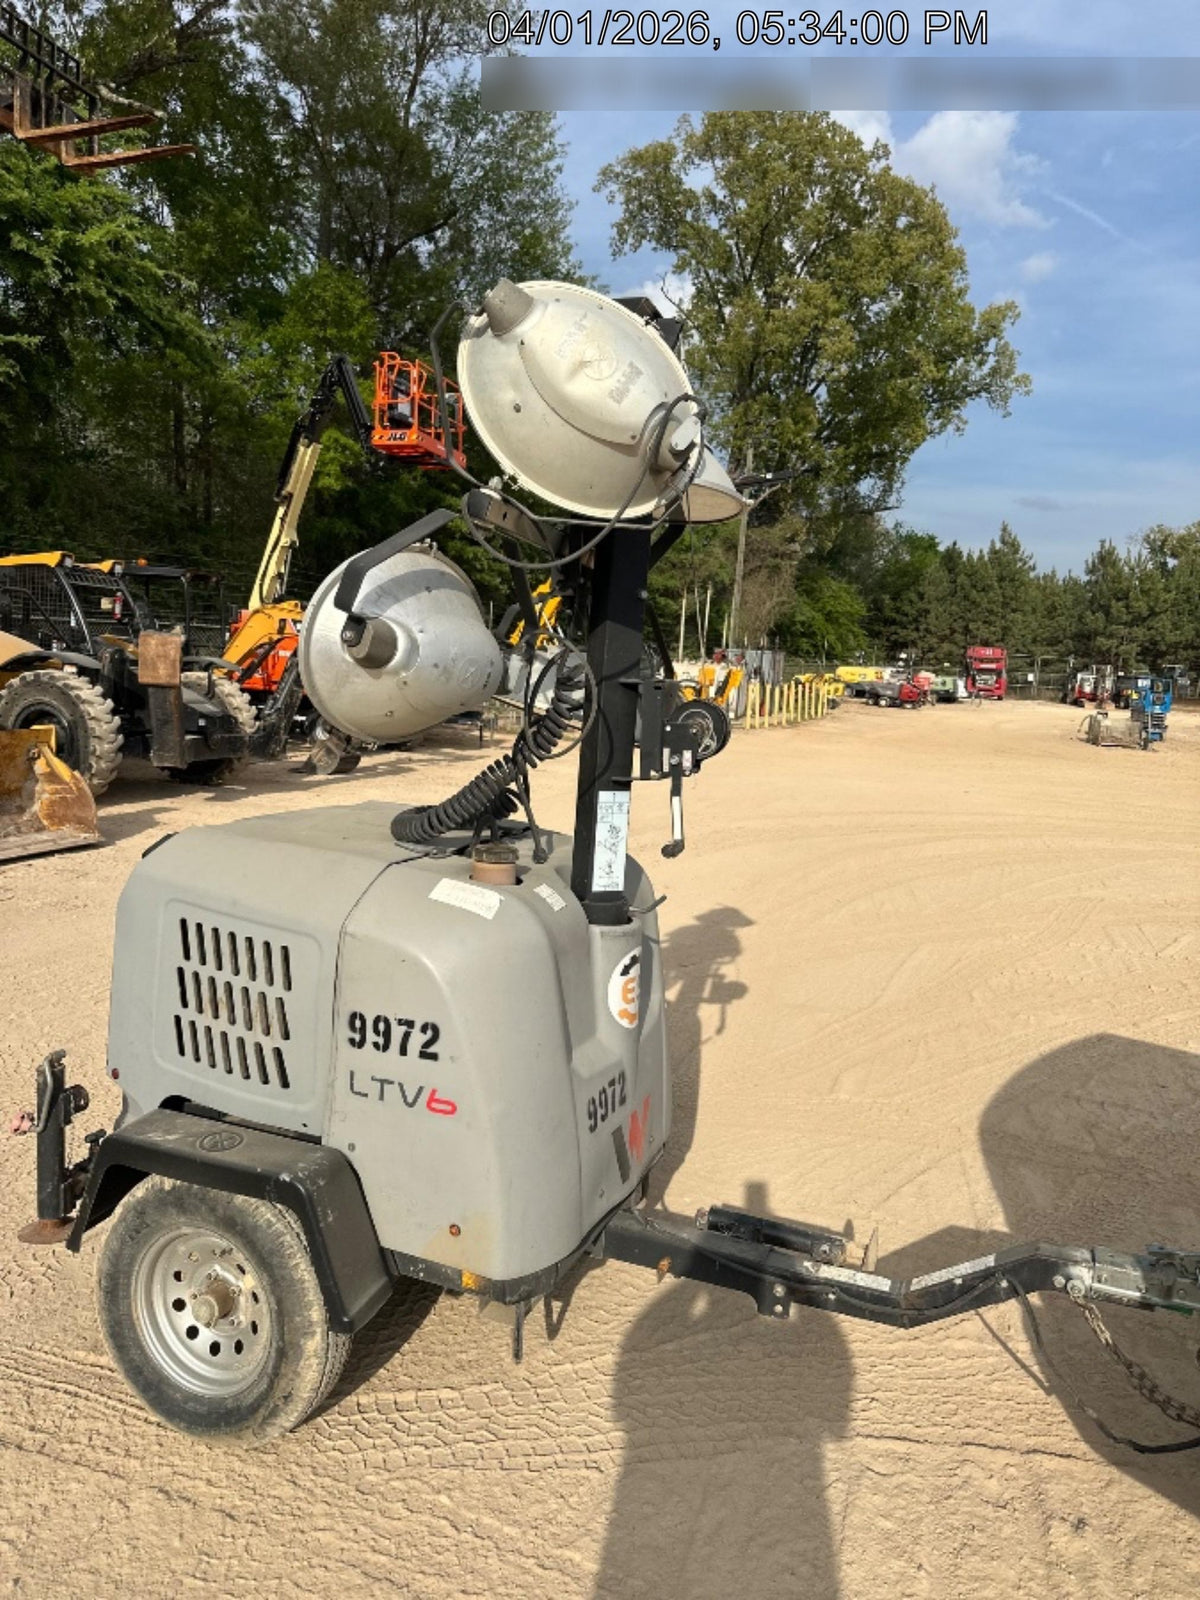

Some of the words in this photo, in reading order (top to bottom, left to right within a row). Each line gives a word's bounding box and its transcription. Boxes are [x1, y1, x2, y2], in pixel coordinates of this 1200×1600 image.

[347, 1010, 441, 1062] 9972
[349, 1069, 458, 1116] LTV6
[587, 1069, 627, 1134] 9972
